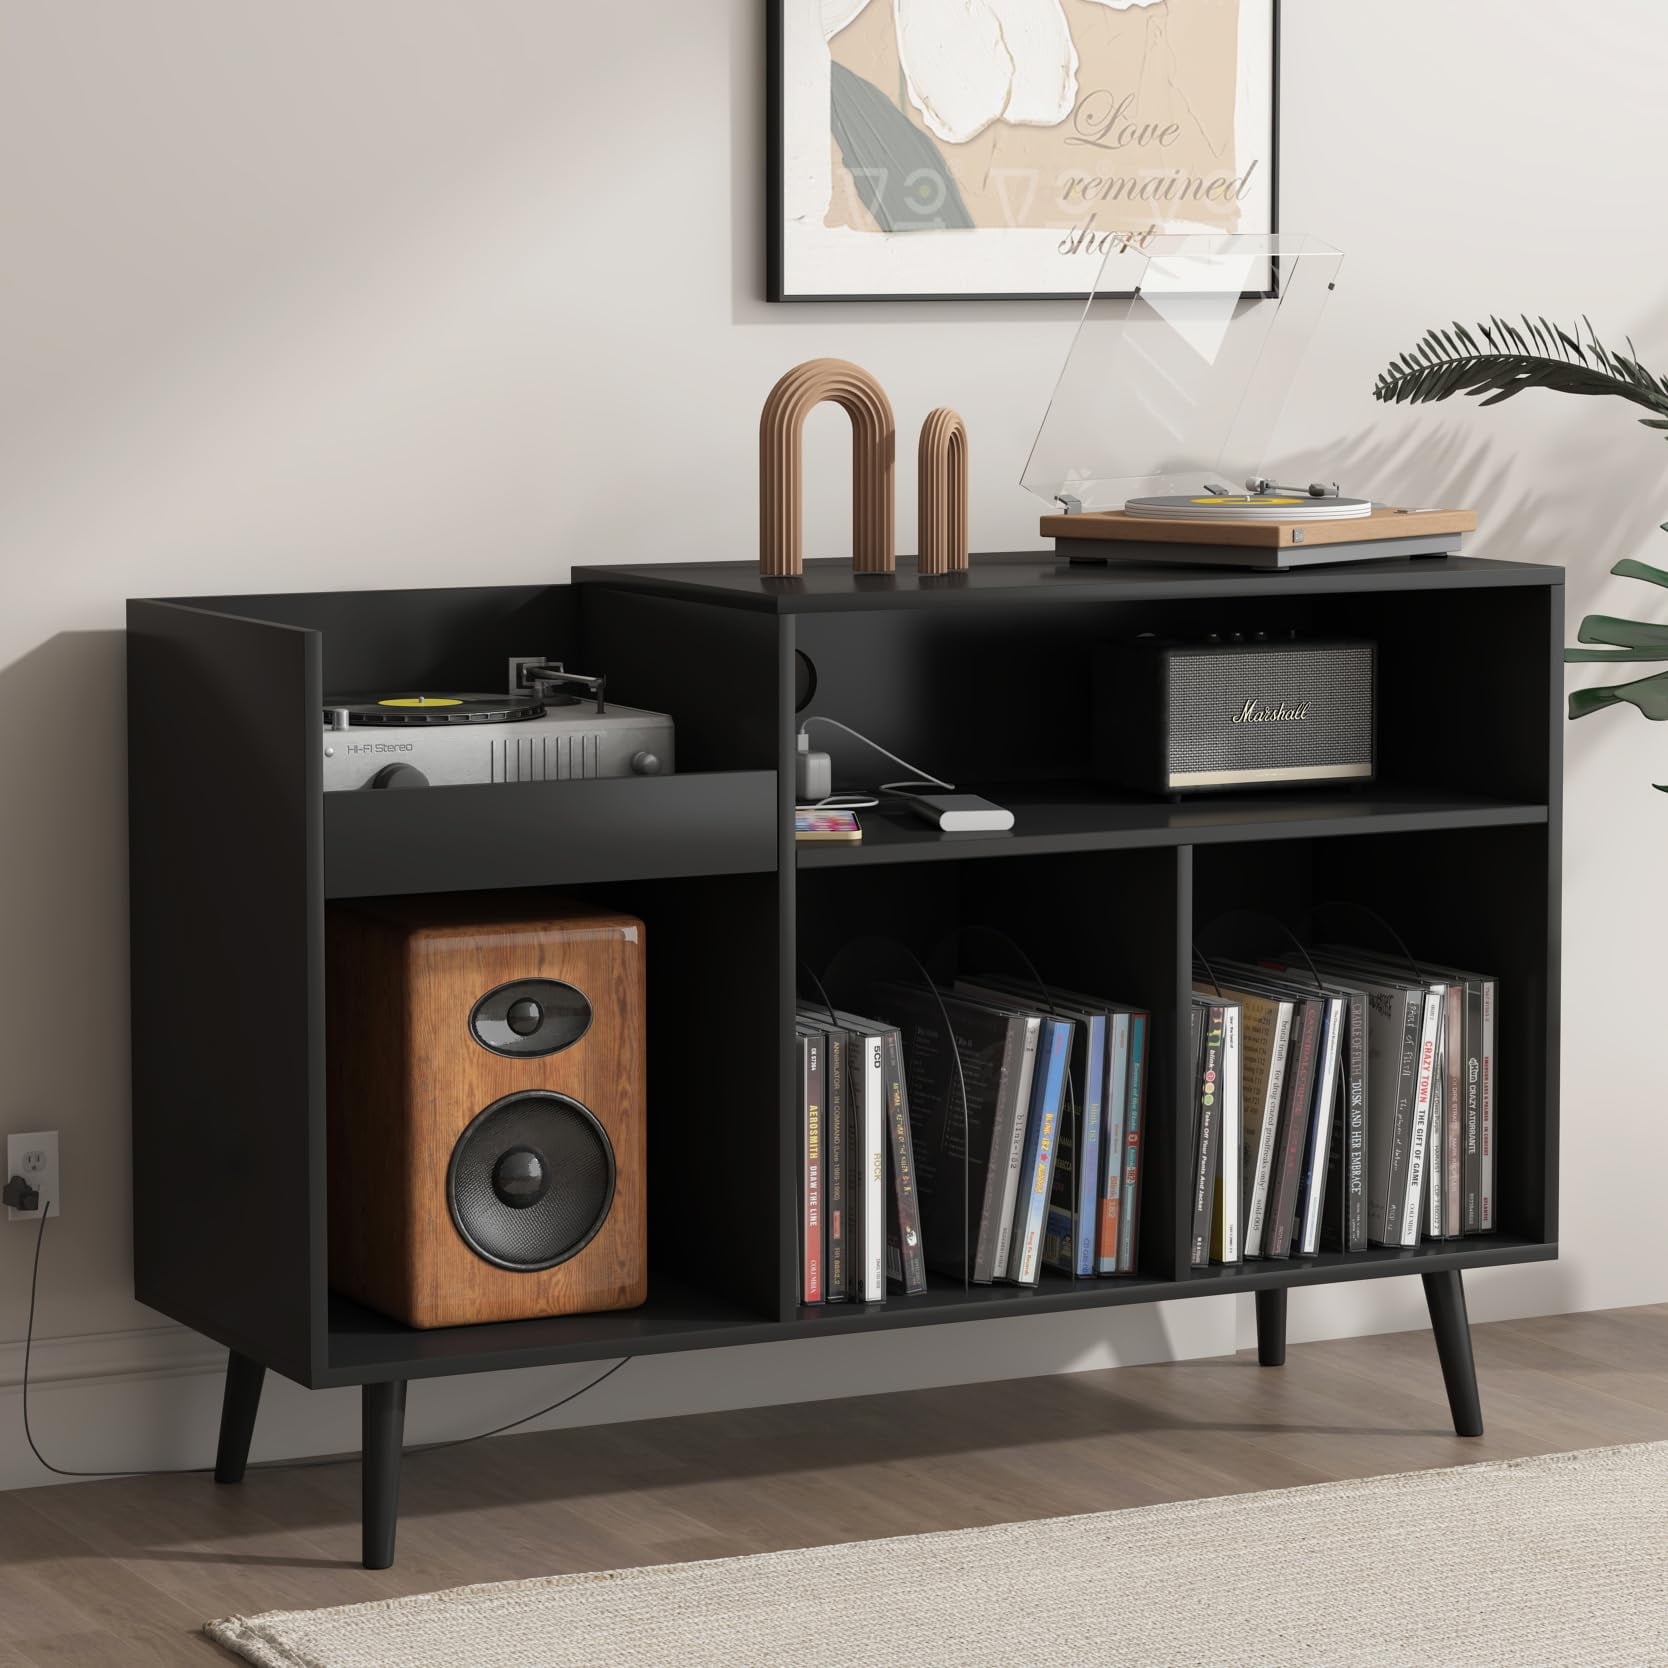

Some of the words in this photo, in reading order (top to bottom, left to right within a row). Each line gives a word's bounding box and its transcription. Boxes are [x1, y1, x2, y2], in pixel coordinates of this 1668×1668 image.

[1065, 89, 1181, 149] Love
[1062, 159, 1258, 202] remained
[1058, 213, 1157, 256] short
[1232, 699, 1312, 723] Marshall
[375, 743, 414, 754] Stereo
[1279, 1020, 1289, 1042] brutal
[1351, 1003, 1362, 1036] CRADLE
[1276, 1044, 1286, 1062] truth
[1351, 1038, 1362, 1049] OF
[833, 1040, 841, 1090] ANNIHILATOR
[873, 1045, 881, 1069] 5CD
[1351, 1051, 1362, 1075] FILTH
[1422, 1040, 1434, 1072] CRAZY
[1274, 1070, 1283, 1081] for
[833, 1096, 841, 1104] IN
[1270, 1082, 1281, 1100] drug
[1418, 1075, 1429, 1104] TOWN
[833, 1105, 841, 1145] COMMAND
[1203, 1111, 1211, 1127] Take
[1267, 1101, 1278, 1126] crazed
[1351, 1109, 1362, 1127] AND
[1417, 1110, 1427, 1126] THE
[808, 1104, 819, 1160] AEROSMITH
[1010, 1114, 1025, 1169] blink-182
[1351, 1131, 1362, 1150] HER
[1415, 1129, 1424, 1147] GIFT
[1468, 1110, 1477, 1155] ATORRANTE
[1201, 1139, 1209, 1155] Your
[1414, 1150, 1422, 1160] OF
[873, 1152, 882, 1183] ROCK
[1200, 1155, 1208, 1175] Pants
[1411, 1163, 1420, 1187] GAME
[808, 1165, 818, 1190] DRAW
[1199, 1175, 1207, 1190] And
[808, 1191, 817, 1206] THE
[1197, 1190, 1206, 1212] Jacket
[808, 1208, 817, 1227] LINE
[1407, 1203, 1416, 1236] COLUMBIA
[810, 1259, 818, 1295] COLUMBIA
